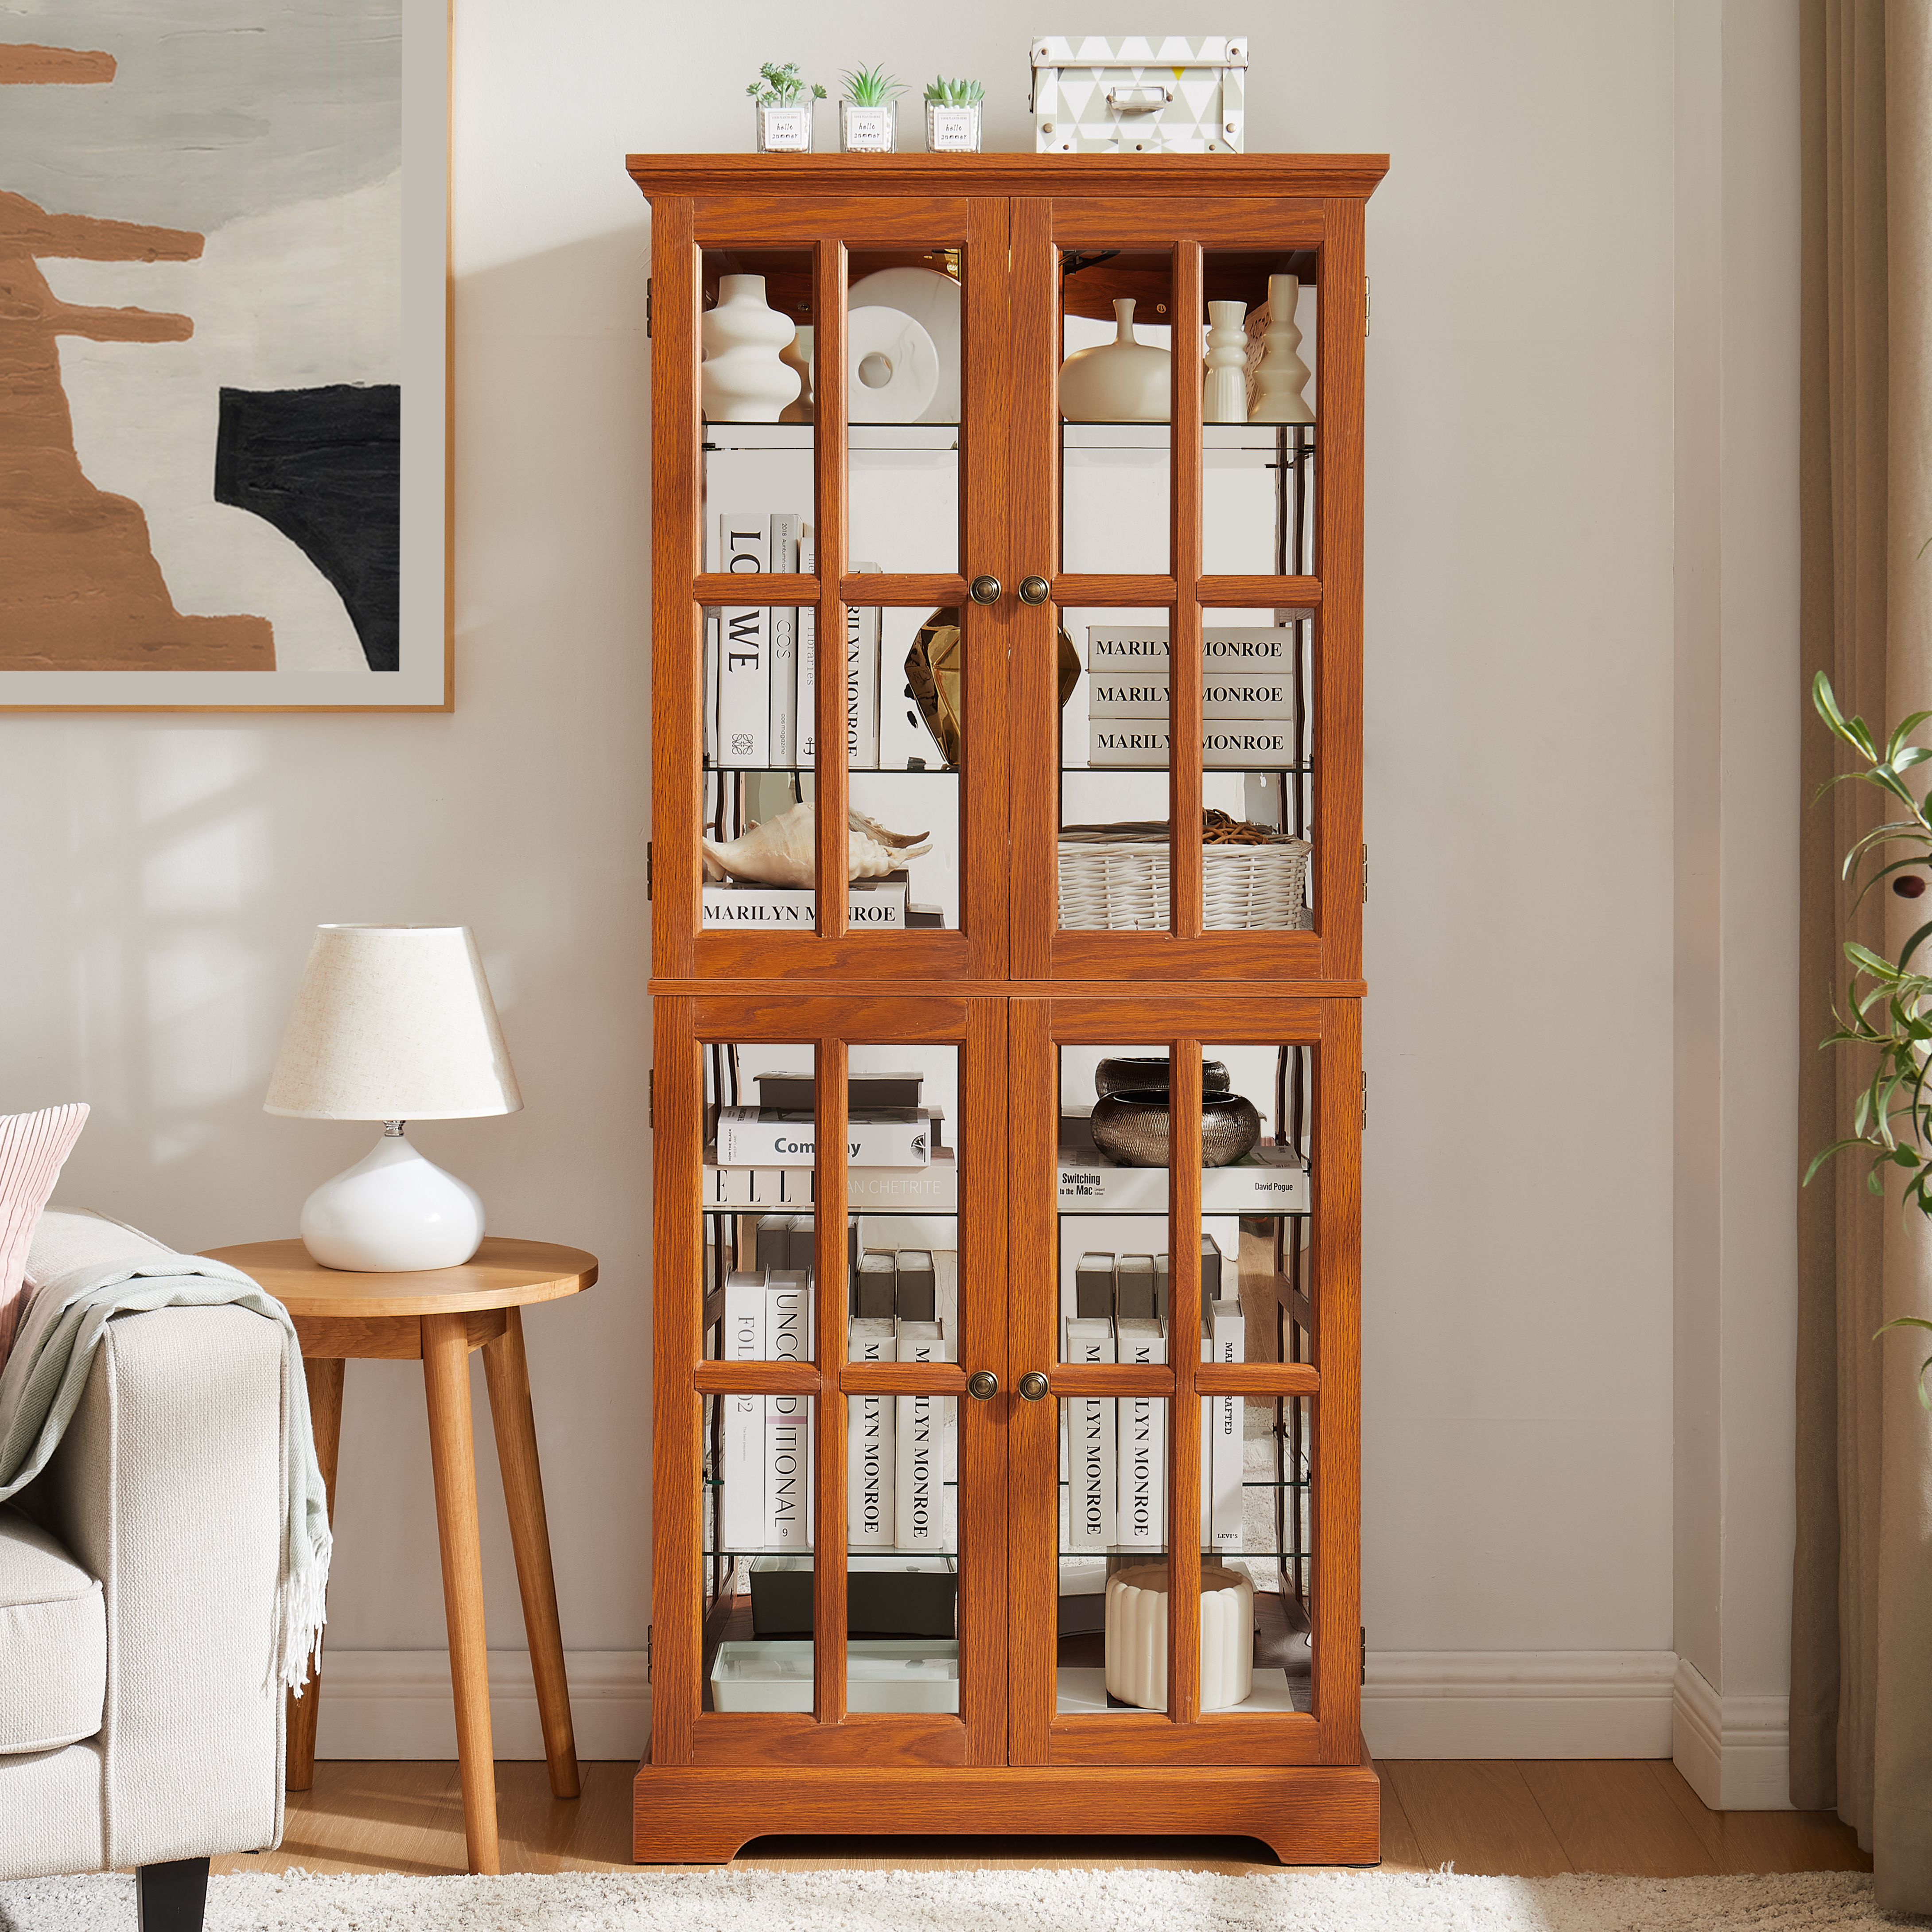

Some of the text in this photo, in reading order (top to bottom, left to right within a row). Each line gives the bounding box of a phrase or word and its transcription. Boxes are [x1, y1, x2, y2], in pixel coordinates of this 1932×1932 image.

[729, 530, 761, 673] LOWE
[777, 619, 791, 659] COS
[1096, 641, 1170, 656] MARILY
[1096, 687, 1170, 701] MARILY
[1097, 734, 1170, 749] MARIL
[703, 906, 896, 921] MARILYN MROE
[774, 1137, 861, 1158] Comy
[1062, 1173, 1100, 1185] Switching
[869, 1180, 941, 1194] CHETRITE
[1076, 1185, 1092, 1195] Mac
[1274, 1182, 1293, 1192] Pogue
[864, 1343, 879, 1533] MLYN MONROE
[913, 1347, 930, 1538] MILYN MONROE
[1086, 1344, 1101, 1535] MLYN MONROE
[1134, 1346, 1150, 1537] MLYN MONROE
